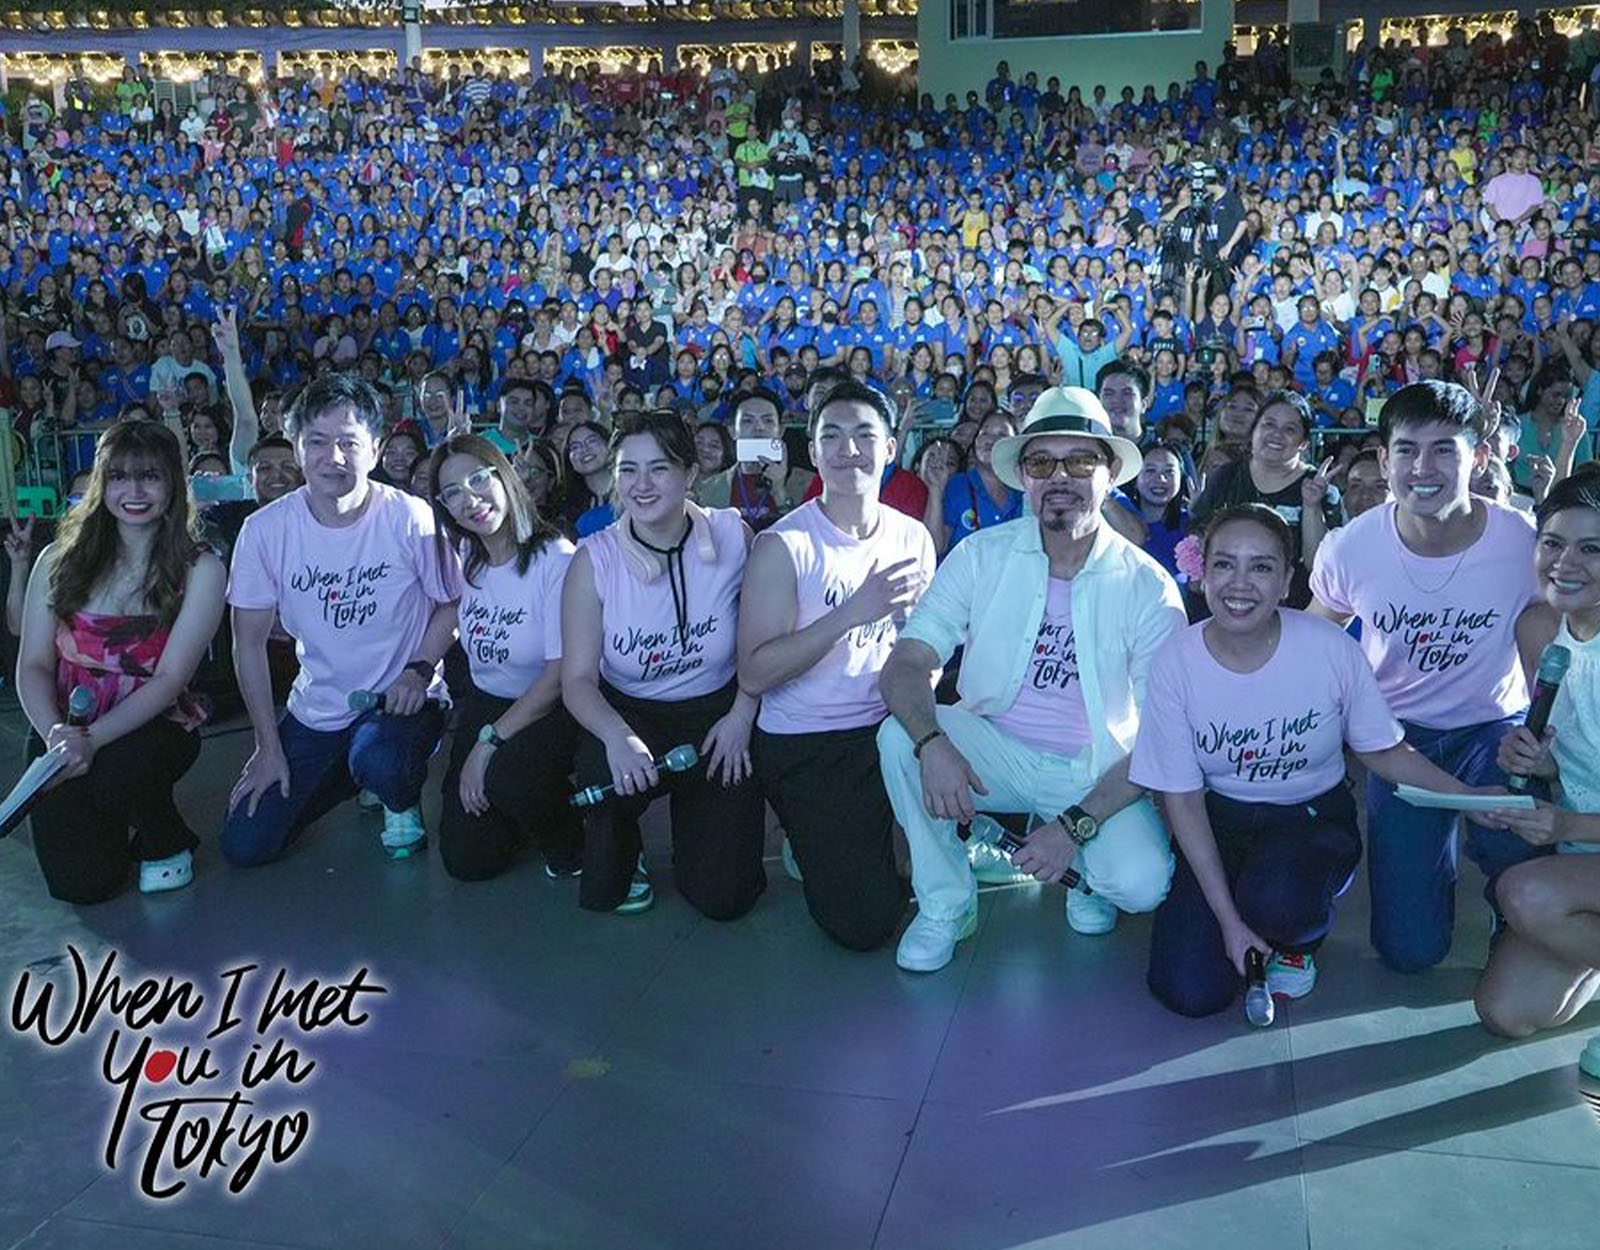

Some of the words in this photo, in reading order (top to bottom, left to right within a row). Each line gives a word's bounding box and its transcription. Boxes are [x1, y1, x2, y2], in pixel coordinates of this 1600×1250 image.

[291, 564, 342, 592] When
[344, 566, 357, 588] I
[357, 561, 391, 584] met
[318, 586, 350, 622] You
[355, 584, 375, 599] in
[330, 599, 377, 629] Tokyo
[1373, 602, 1438, 634] When
[1439, 607, 1454, 629] I
[1455, 608, 1500, 630] met
[494, 626, 510, 640] in
[613, 626, 668, 656] When
[1404, 630, 1444, 663] You
[1451, 631, 1474, 645] in
[473, 638, 510, 664] Tokyo
[638, 650, 674, 680] You
[1196, 721, 1260, 754] When
[1263, 718, 1277, 745] I
[1281, 708, 1321, 740] met
[1227, 747, 1271, 777] You
[1280, 740, 1307, 757] in
[1246, 757, 1308, 782] Tokyo
